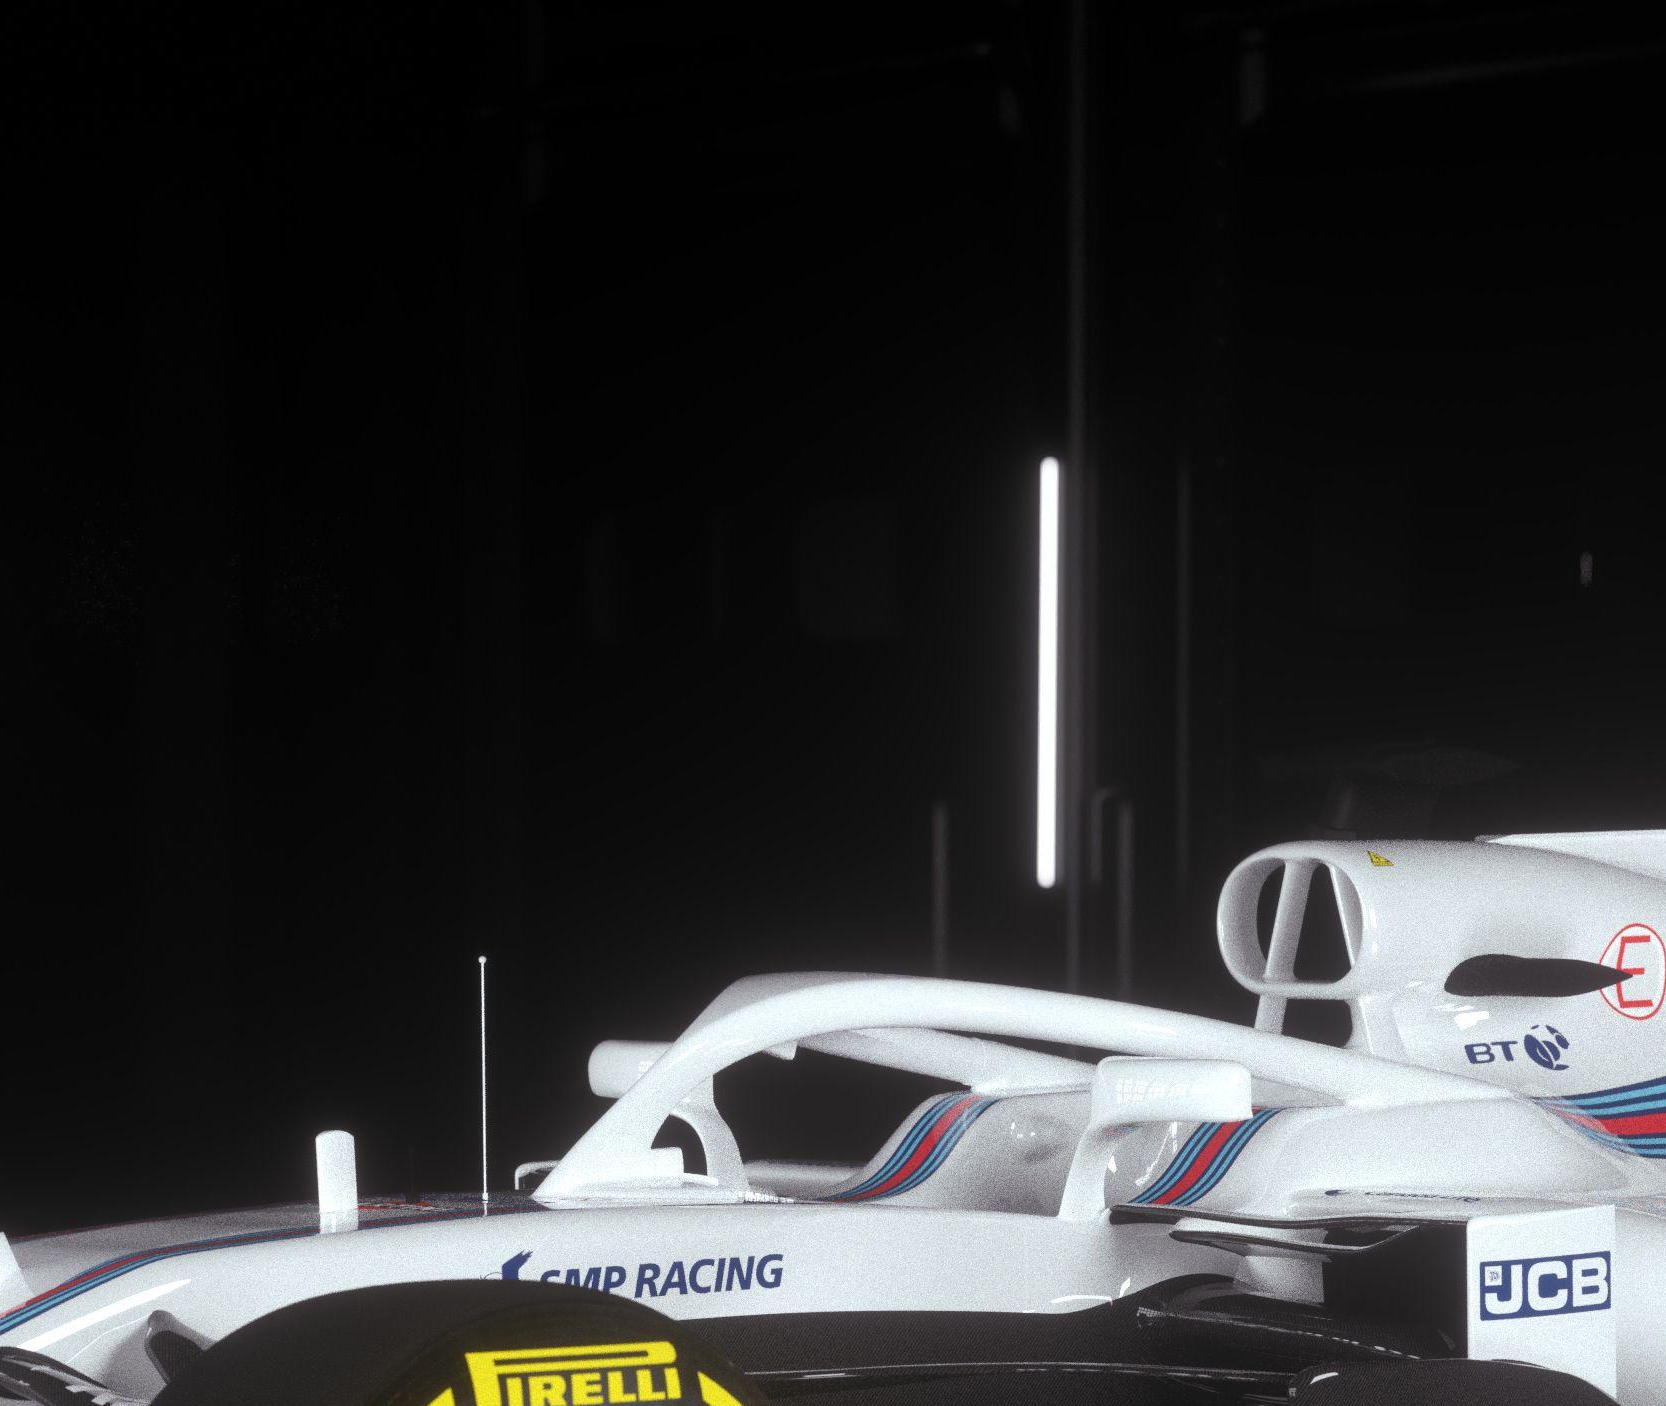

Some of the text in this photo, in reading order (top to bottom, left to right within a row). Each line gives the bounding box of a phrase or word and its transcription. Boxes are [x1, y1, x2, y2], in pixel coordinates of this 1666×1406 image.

[1617, 935, 1654, 1009] E
[1464, 1040, 1518, 1065] BT
[634, 1253, 784, 1299] RACING
[1484, 1256, 1609, 1315] JCB
